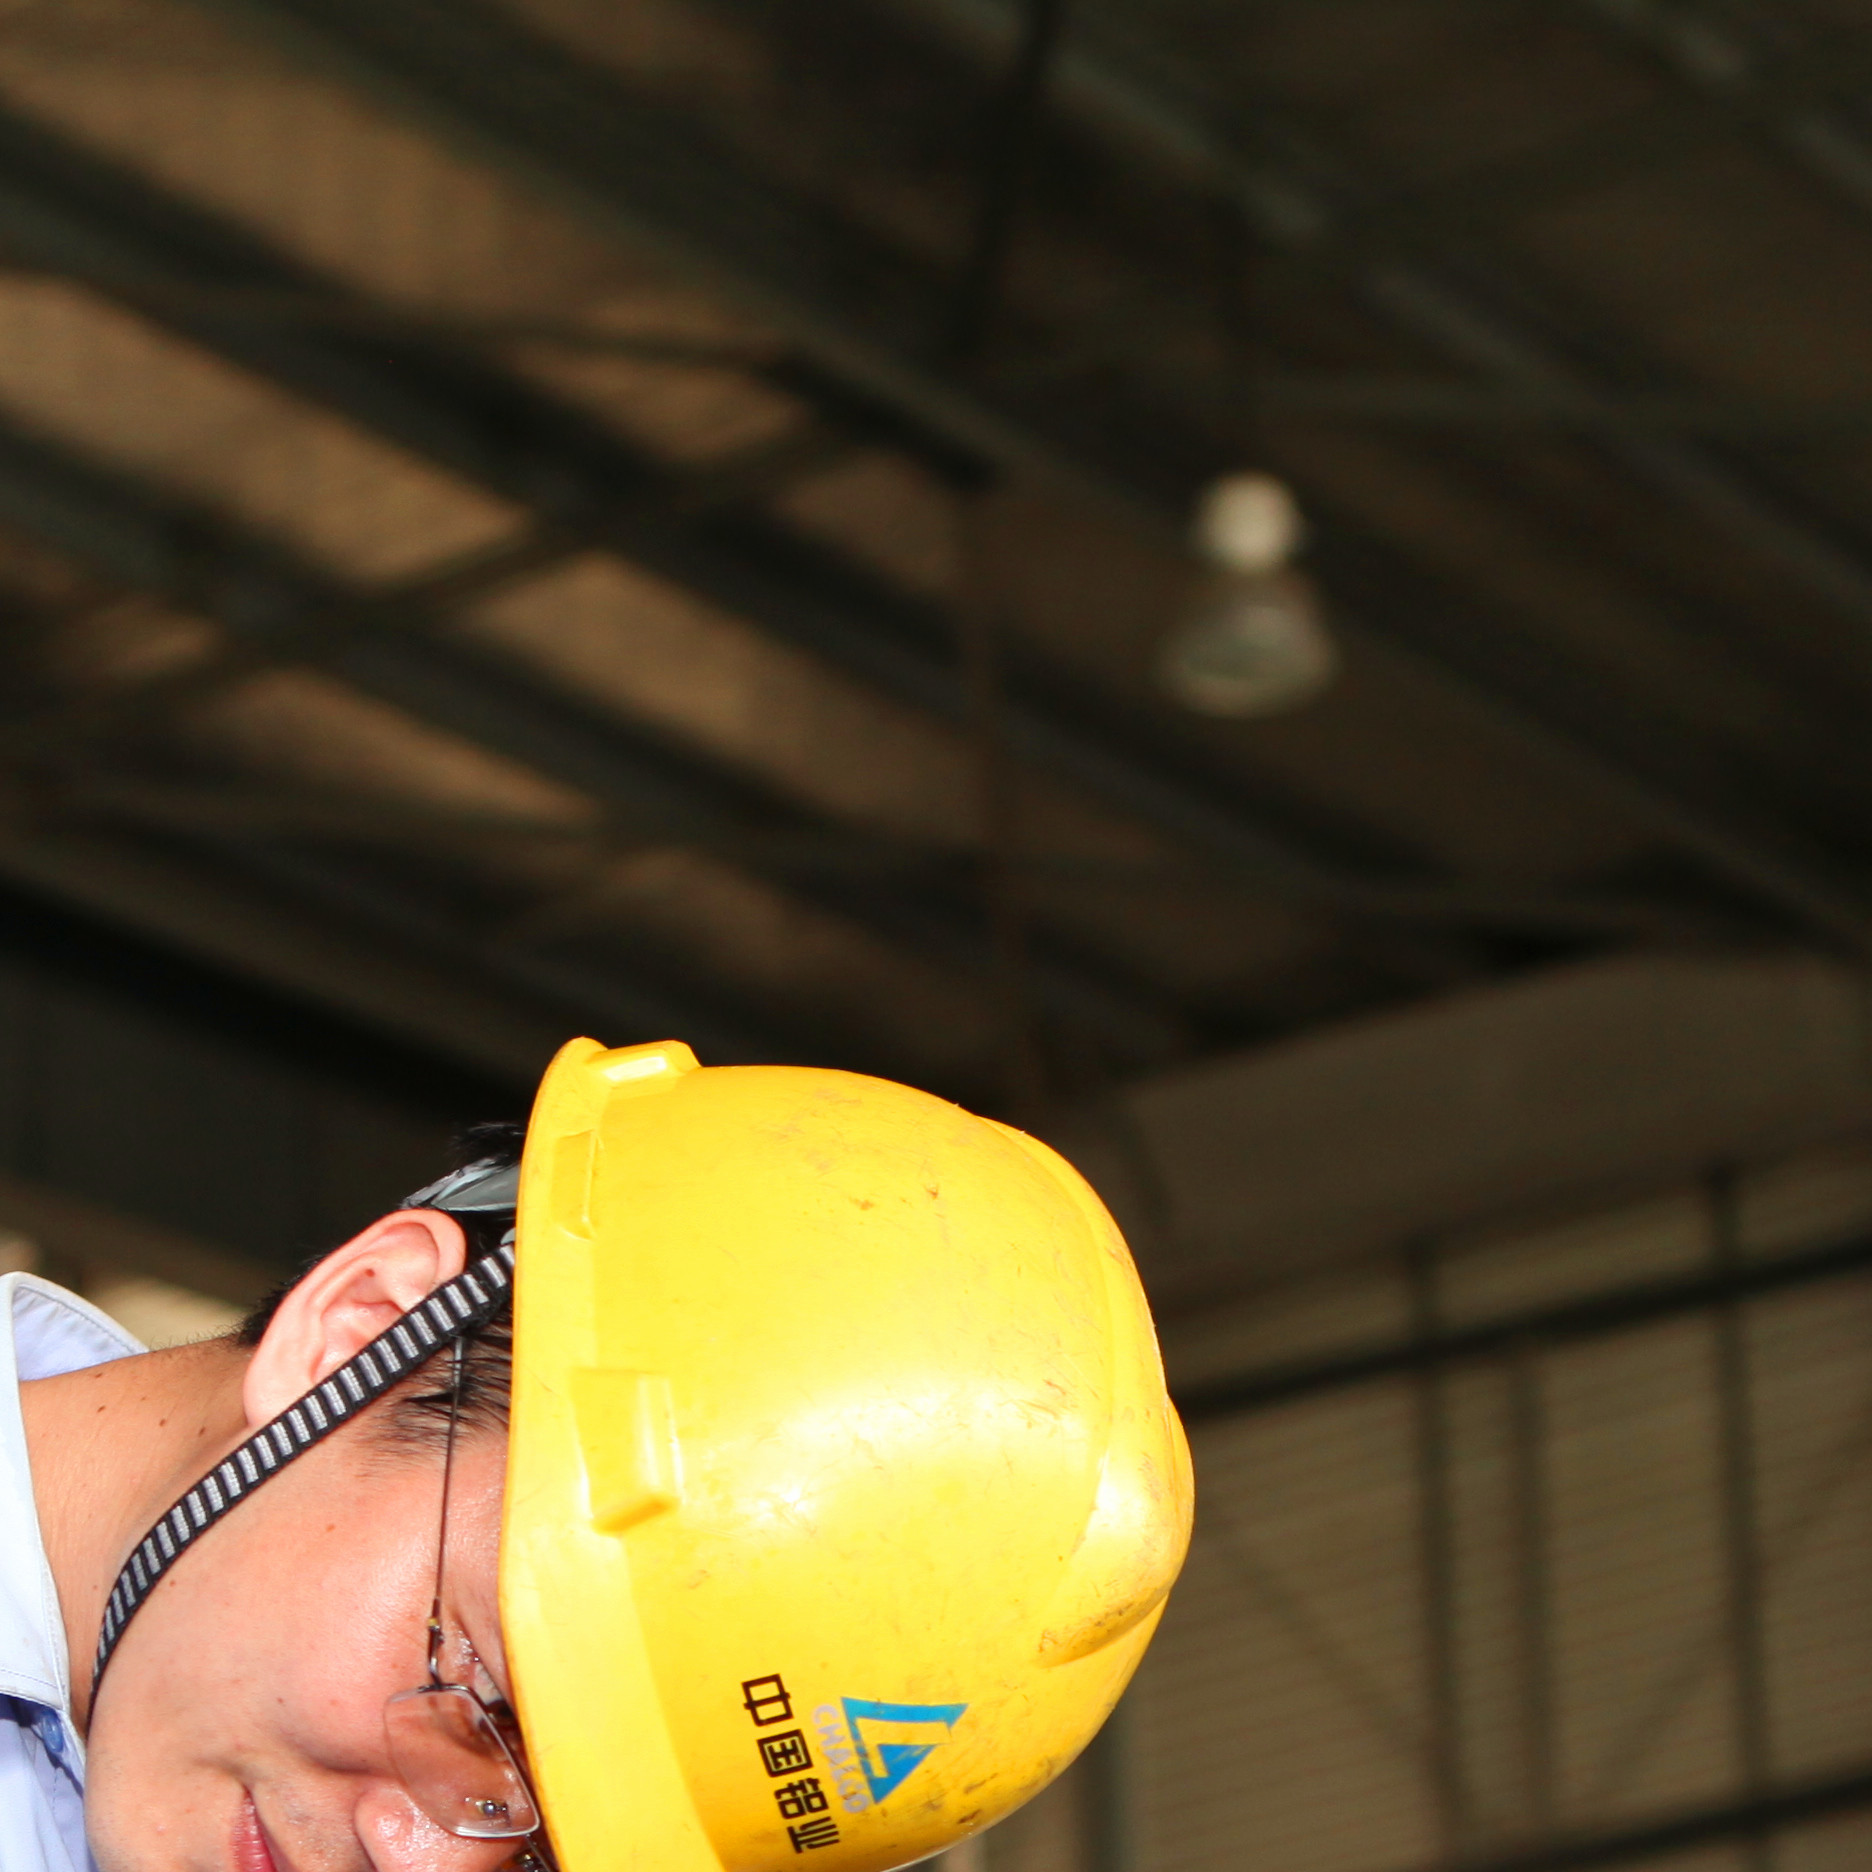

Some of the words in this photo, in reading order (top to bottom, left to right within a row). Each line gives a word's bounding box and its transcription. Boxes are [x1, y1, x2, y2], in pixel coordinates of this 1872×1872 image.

[742, 1674, 840, 1853] 中国铝业
[812, 1704, 869, 1814] CHALCO
